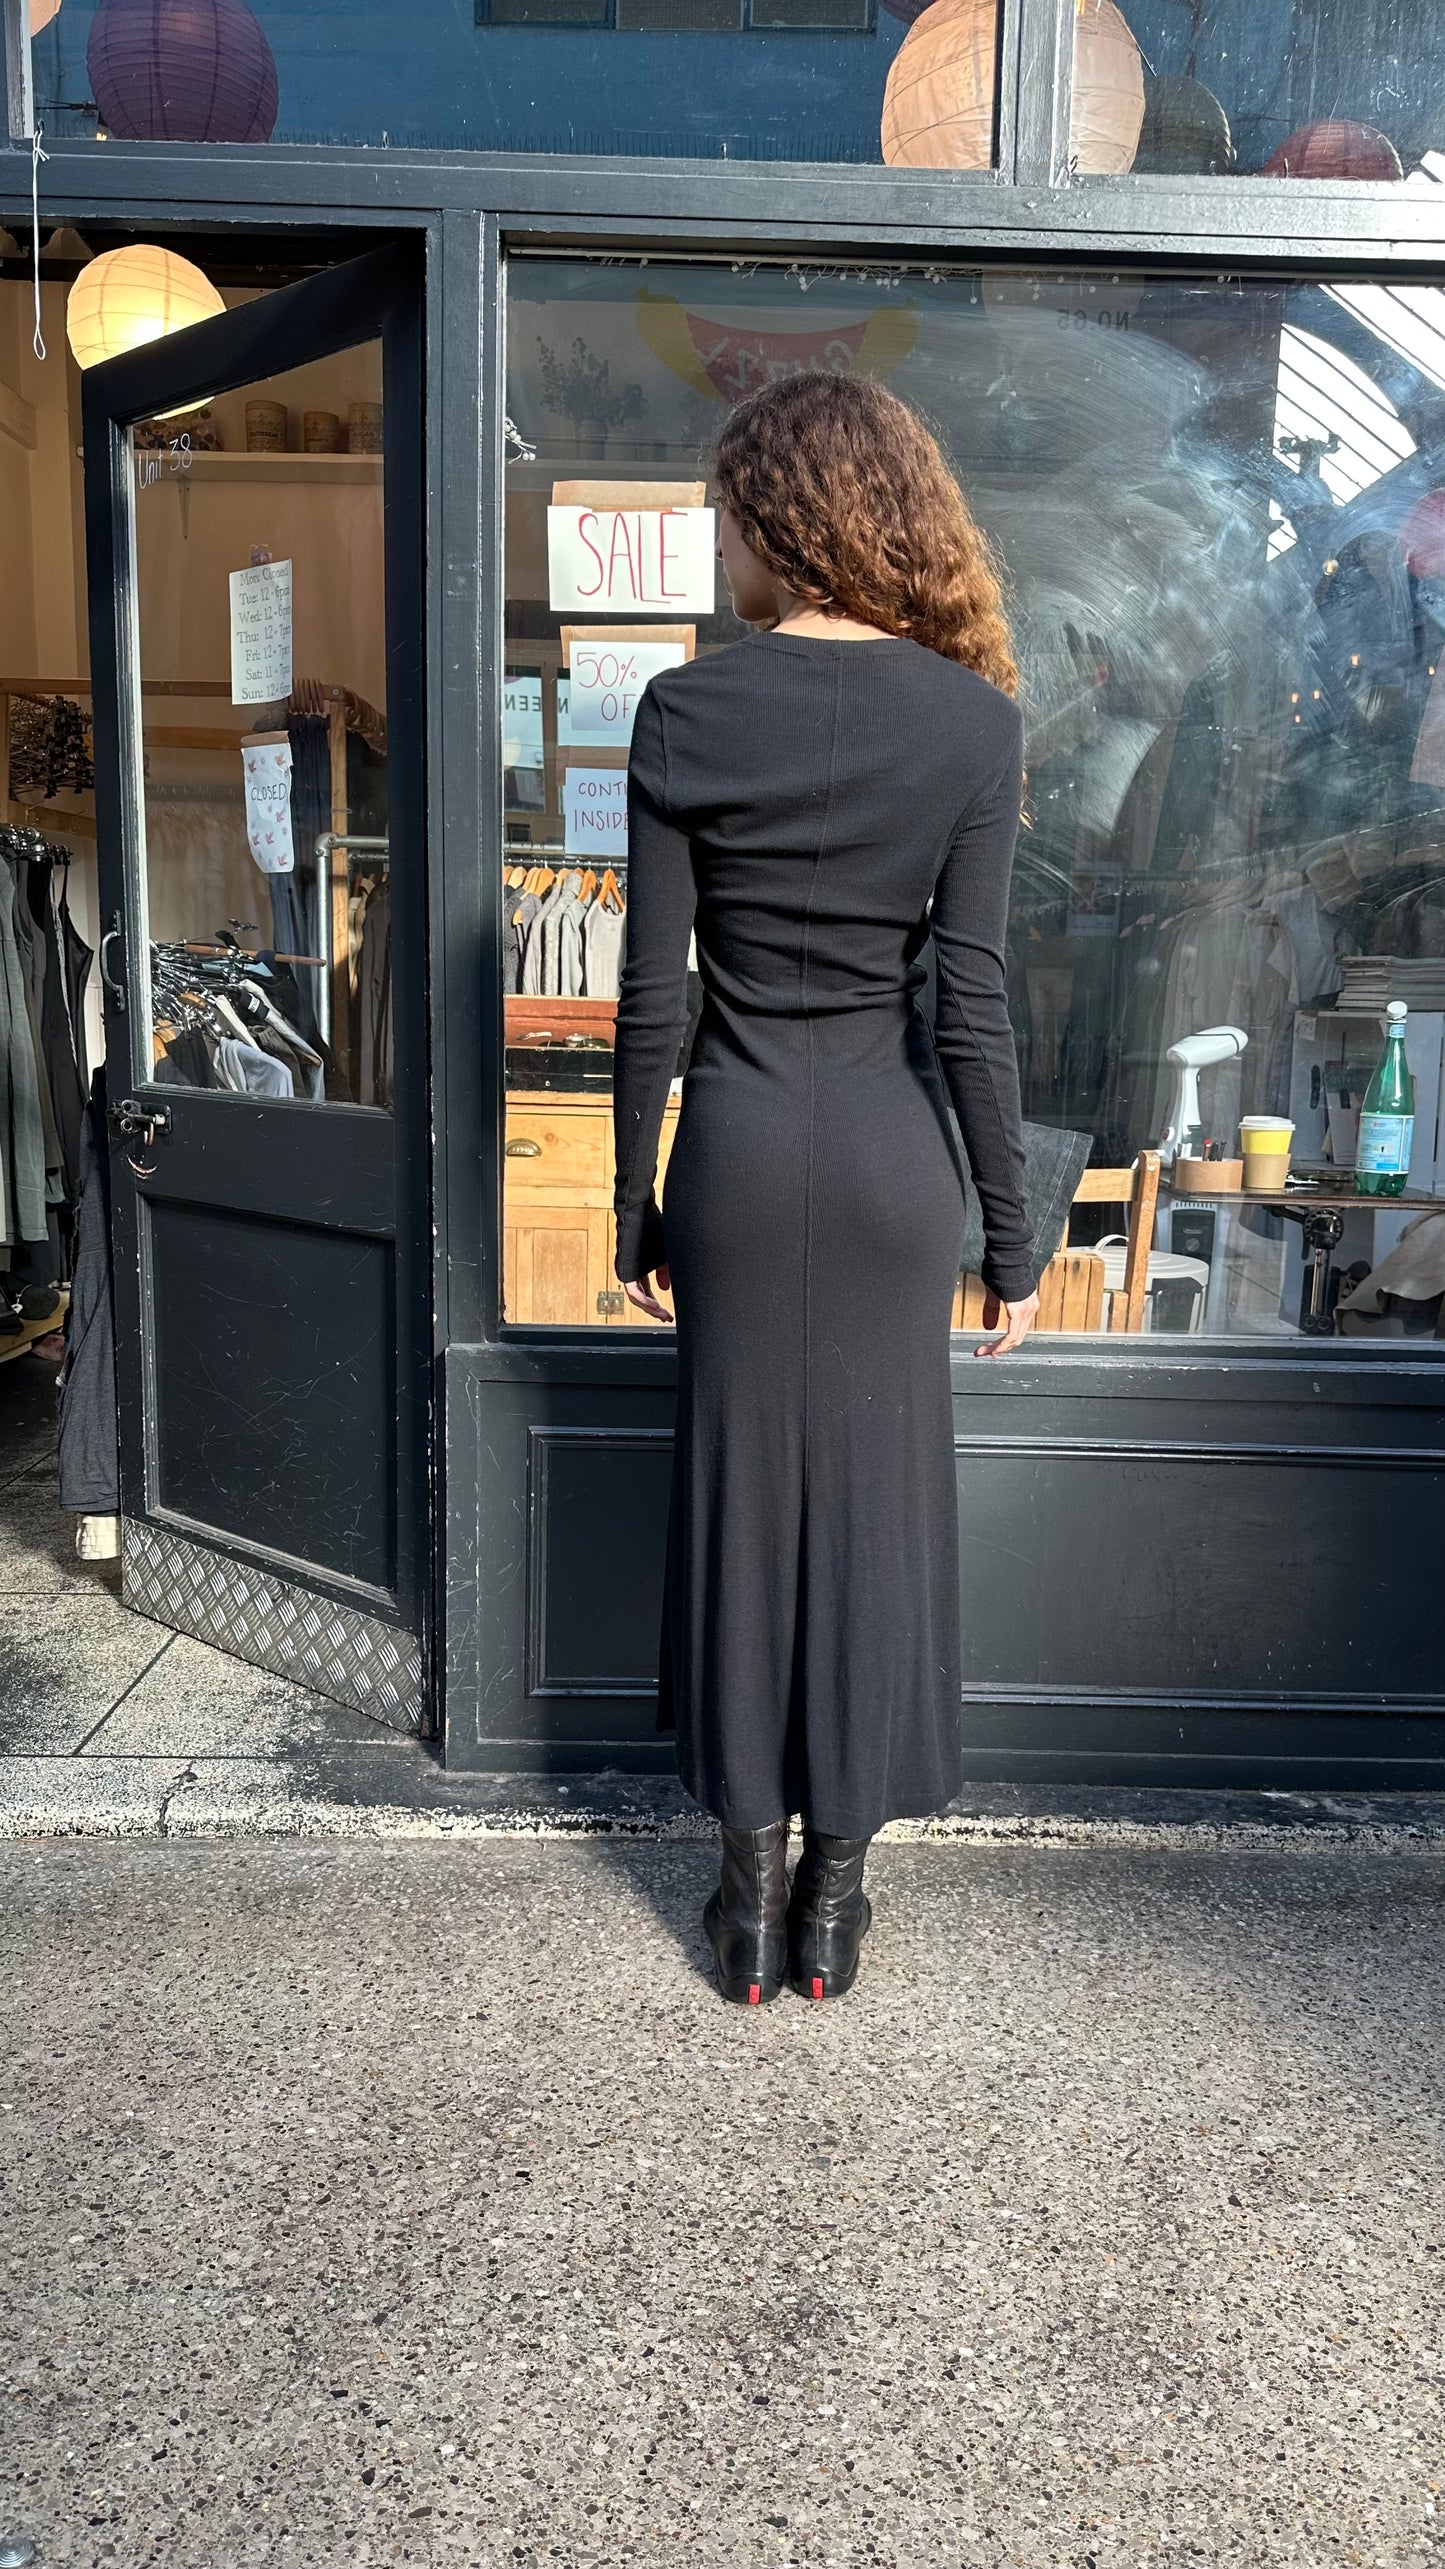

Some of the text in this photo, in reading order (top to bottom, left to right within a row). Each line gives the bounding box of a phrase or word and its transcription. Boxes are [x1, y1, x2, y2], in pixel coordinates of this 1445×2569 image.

[138, 433, 192, 489] Unit 38
[577, 512, 688, 604] SALE
[240, 563, 289, 586] Mon: Closed
[239, 593, 258, 605] Tue:
[238, 610, 262, 624] Wed:
[236, 631, 259, 643] Thu:
[245, 649, 261, 661] Fri:
[245, 668, 262, 680] Sat:
[577, 651, 637, 688] 50%
[241, 687, 263, 699] Sun:
[601, 693, 641, 721] OF
[251, 782, 287, 802] CLOSED
[578, 781, 628, 797] CONTI
